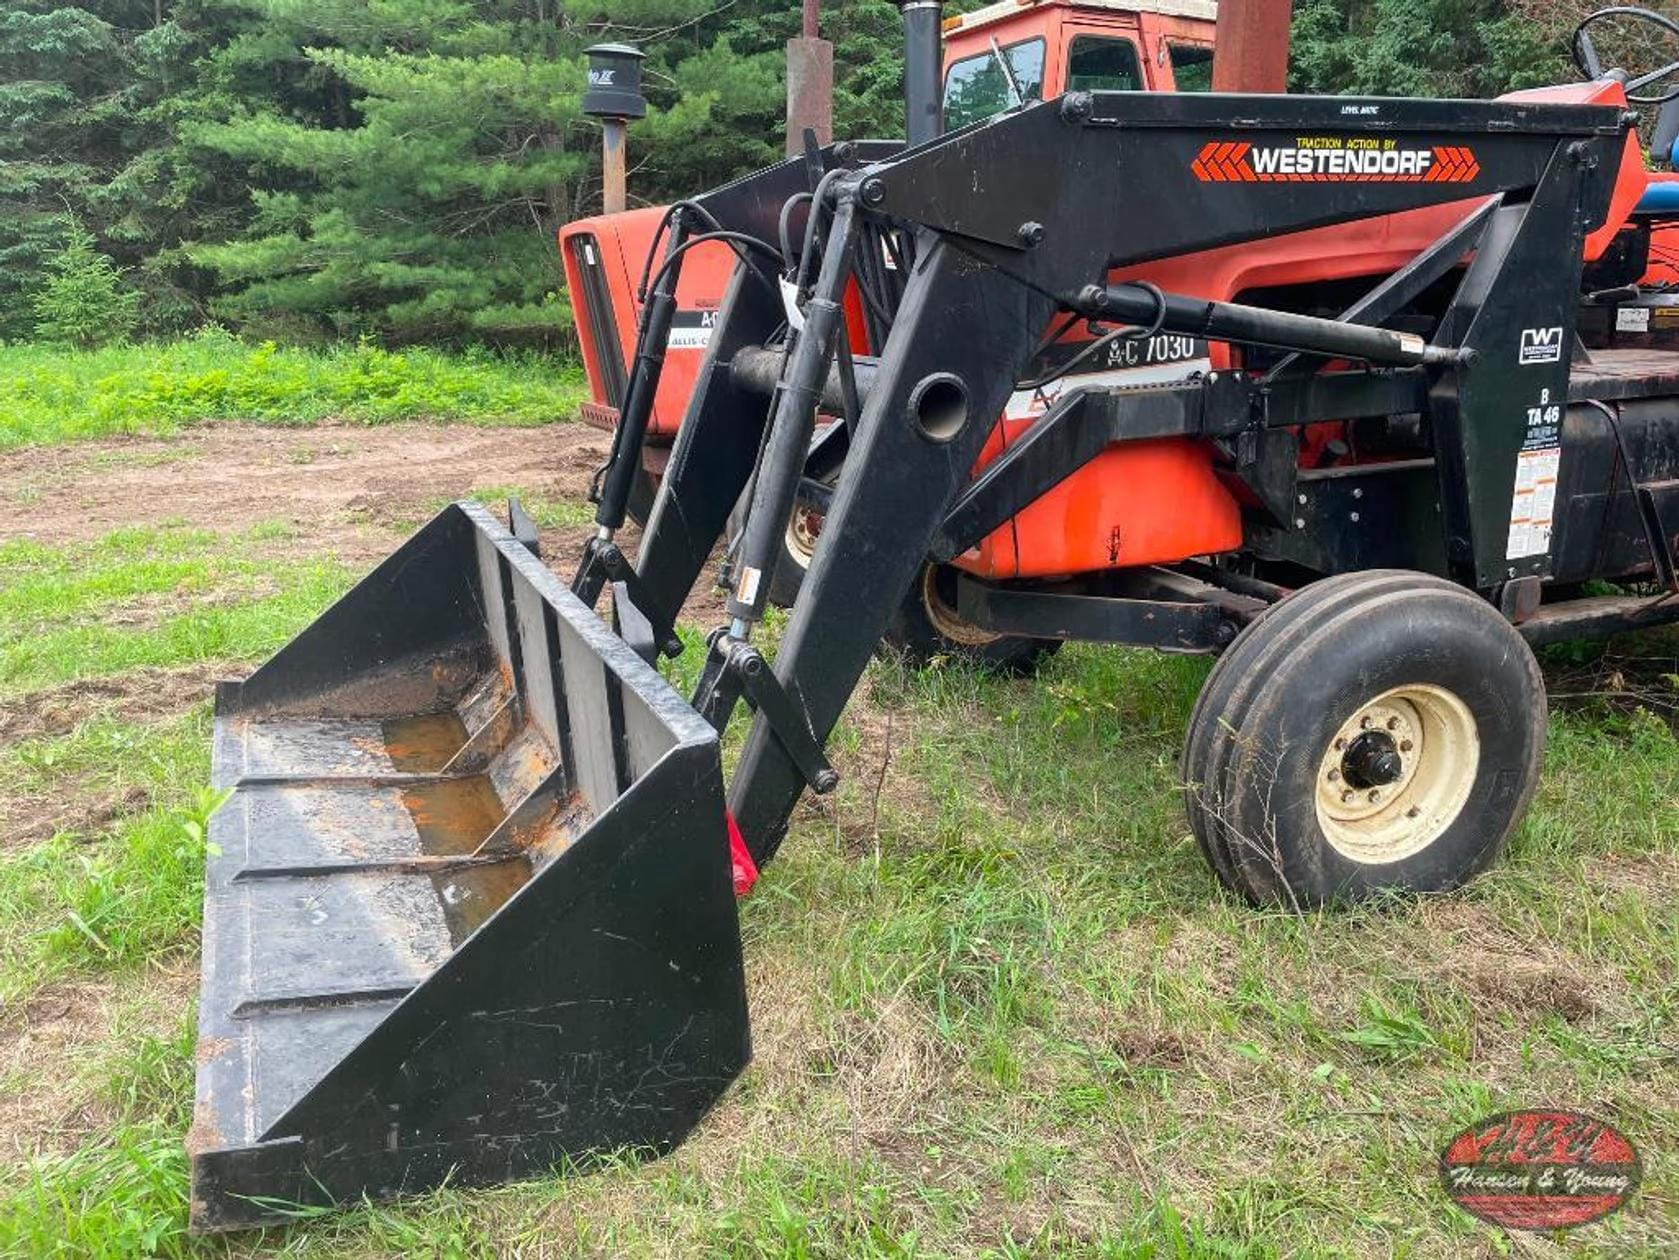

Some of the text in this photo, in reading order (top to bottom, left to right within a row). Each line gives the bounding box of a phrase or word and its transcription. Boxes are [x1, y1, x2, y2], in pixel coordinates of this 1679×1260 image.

[1296, 138, 1397, 150] TRACTION ACTION BY
[1252, 147, 1431, 175] WESTENDORF
[1147, 335, 1194, 361] 7030
[1527, 408, 1542, 425] TA
